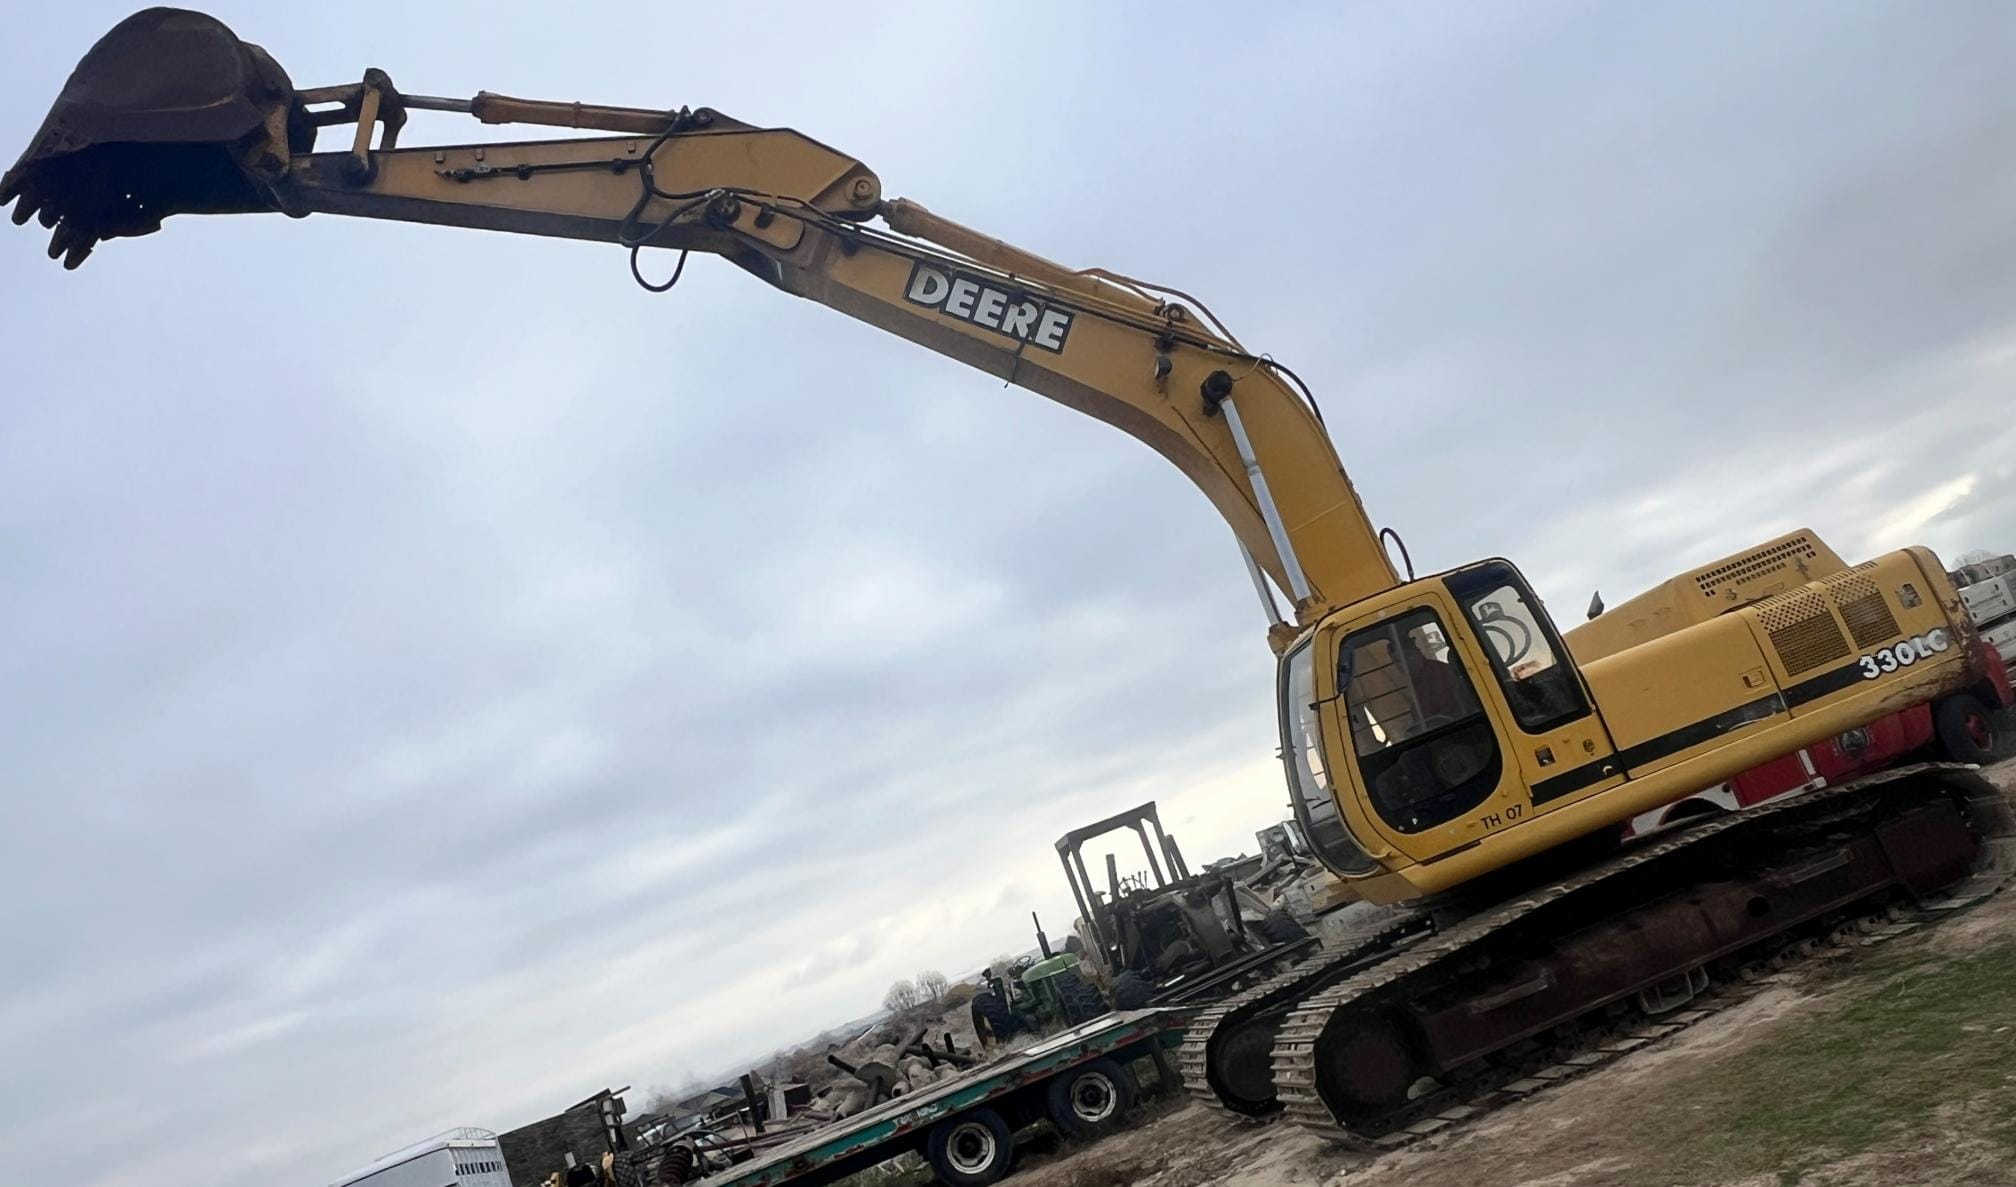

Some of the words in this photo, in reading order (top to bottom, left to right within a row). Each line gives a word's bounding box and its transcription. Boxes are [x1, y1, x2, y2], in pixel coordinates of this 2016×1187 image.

[908, 266, 1069, 351] DEERE
[1859, 628, 1948, 679] 330LC
[1480, 814, 1502, 830] TH
[1505, 804, 1523, 820] 07
